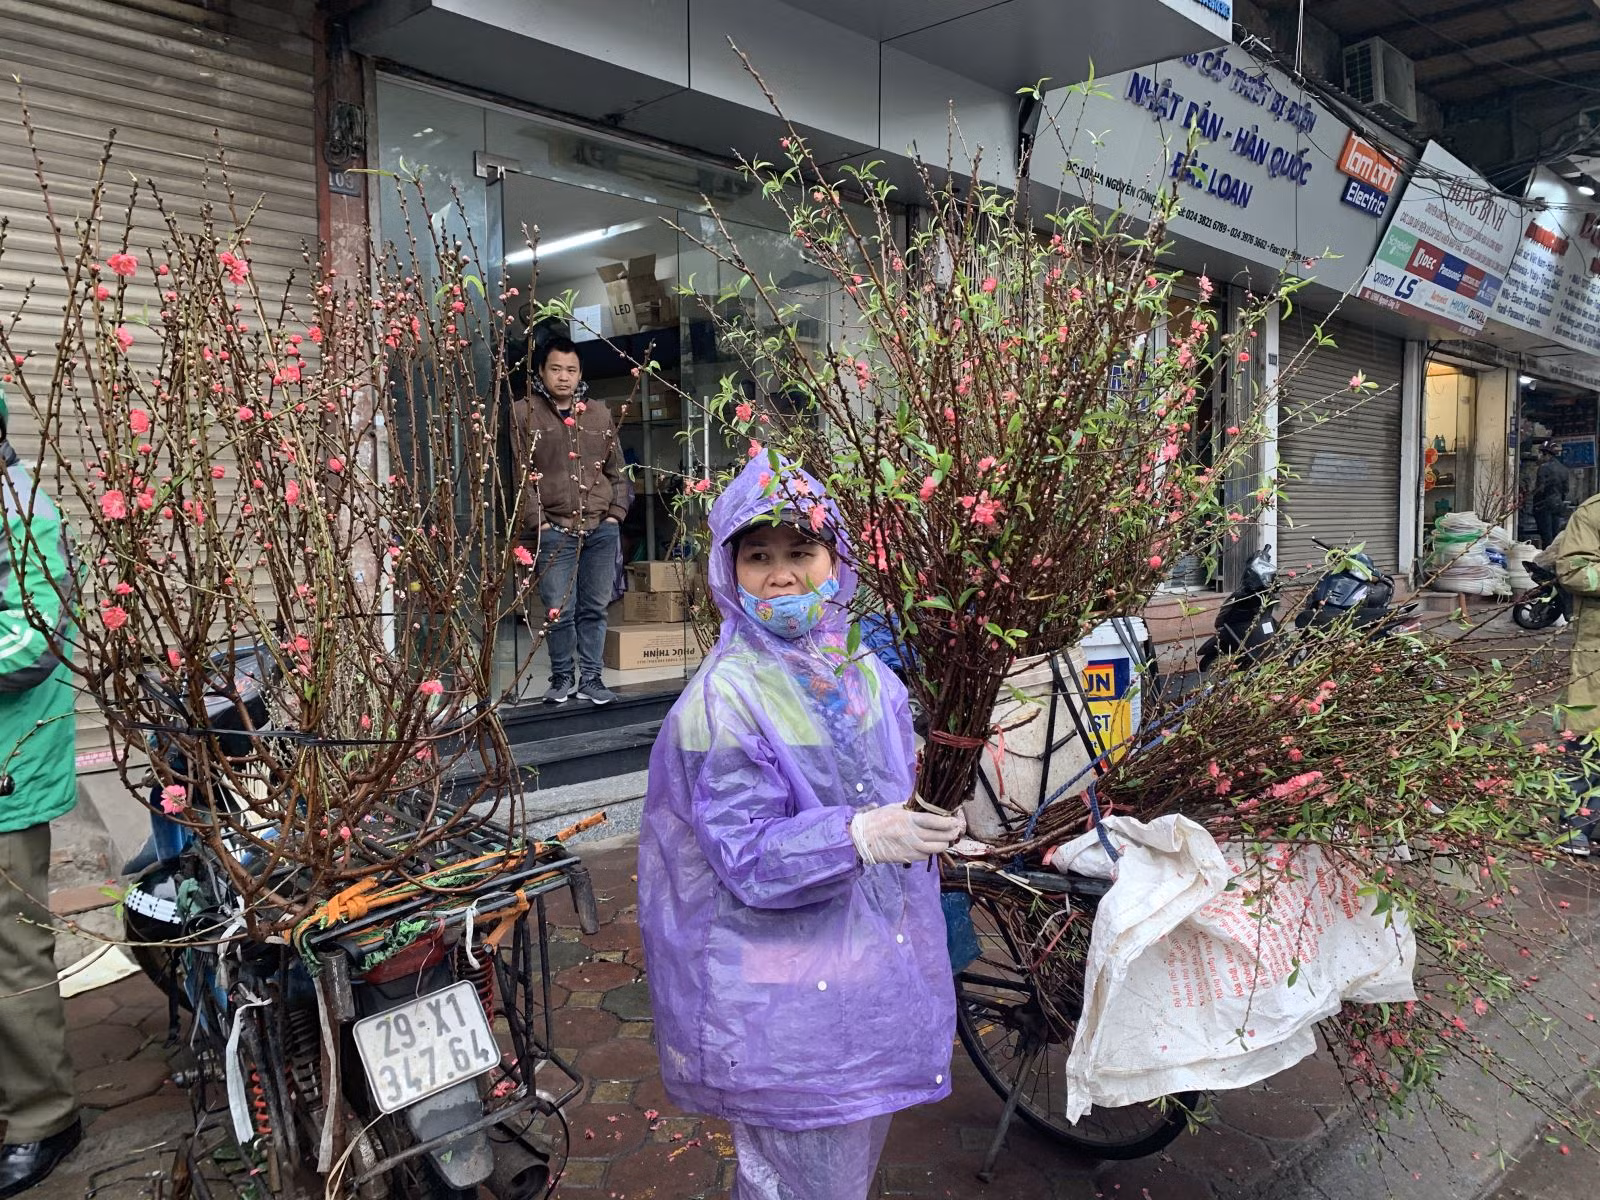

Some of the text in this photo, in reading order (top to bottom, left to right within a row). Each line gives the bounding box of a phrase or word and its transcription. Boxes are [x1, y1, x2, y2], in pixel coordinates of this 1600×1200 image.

[1268, 147, 1313, 186] QUỐC
[329, 172, 354, 189] 103
[1208, 168, 1253, 209] LOAN
[1346, 182, 1385, 215] Electric
[1185, 209, 1198, 223] 024
[1212, 220, 1228, 234] 6789
[1420, 252, 1438, 271] IDEC
[1394, 275, 1419, 299] LS
[614, 303, 631, 316] LED
[643, 647, 695, 660] PHÚC THỊNH
[376, 993, 466, 1058] 29-X1
[379, 1029, 489, 1102] 347.64
